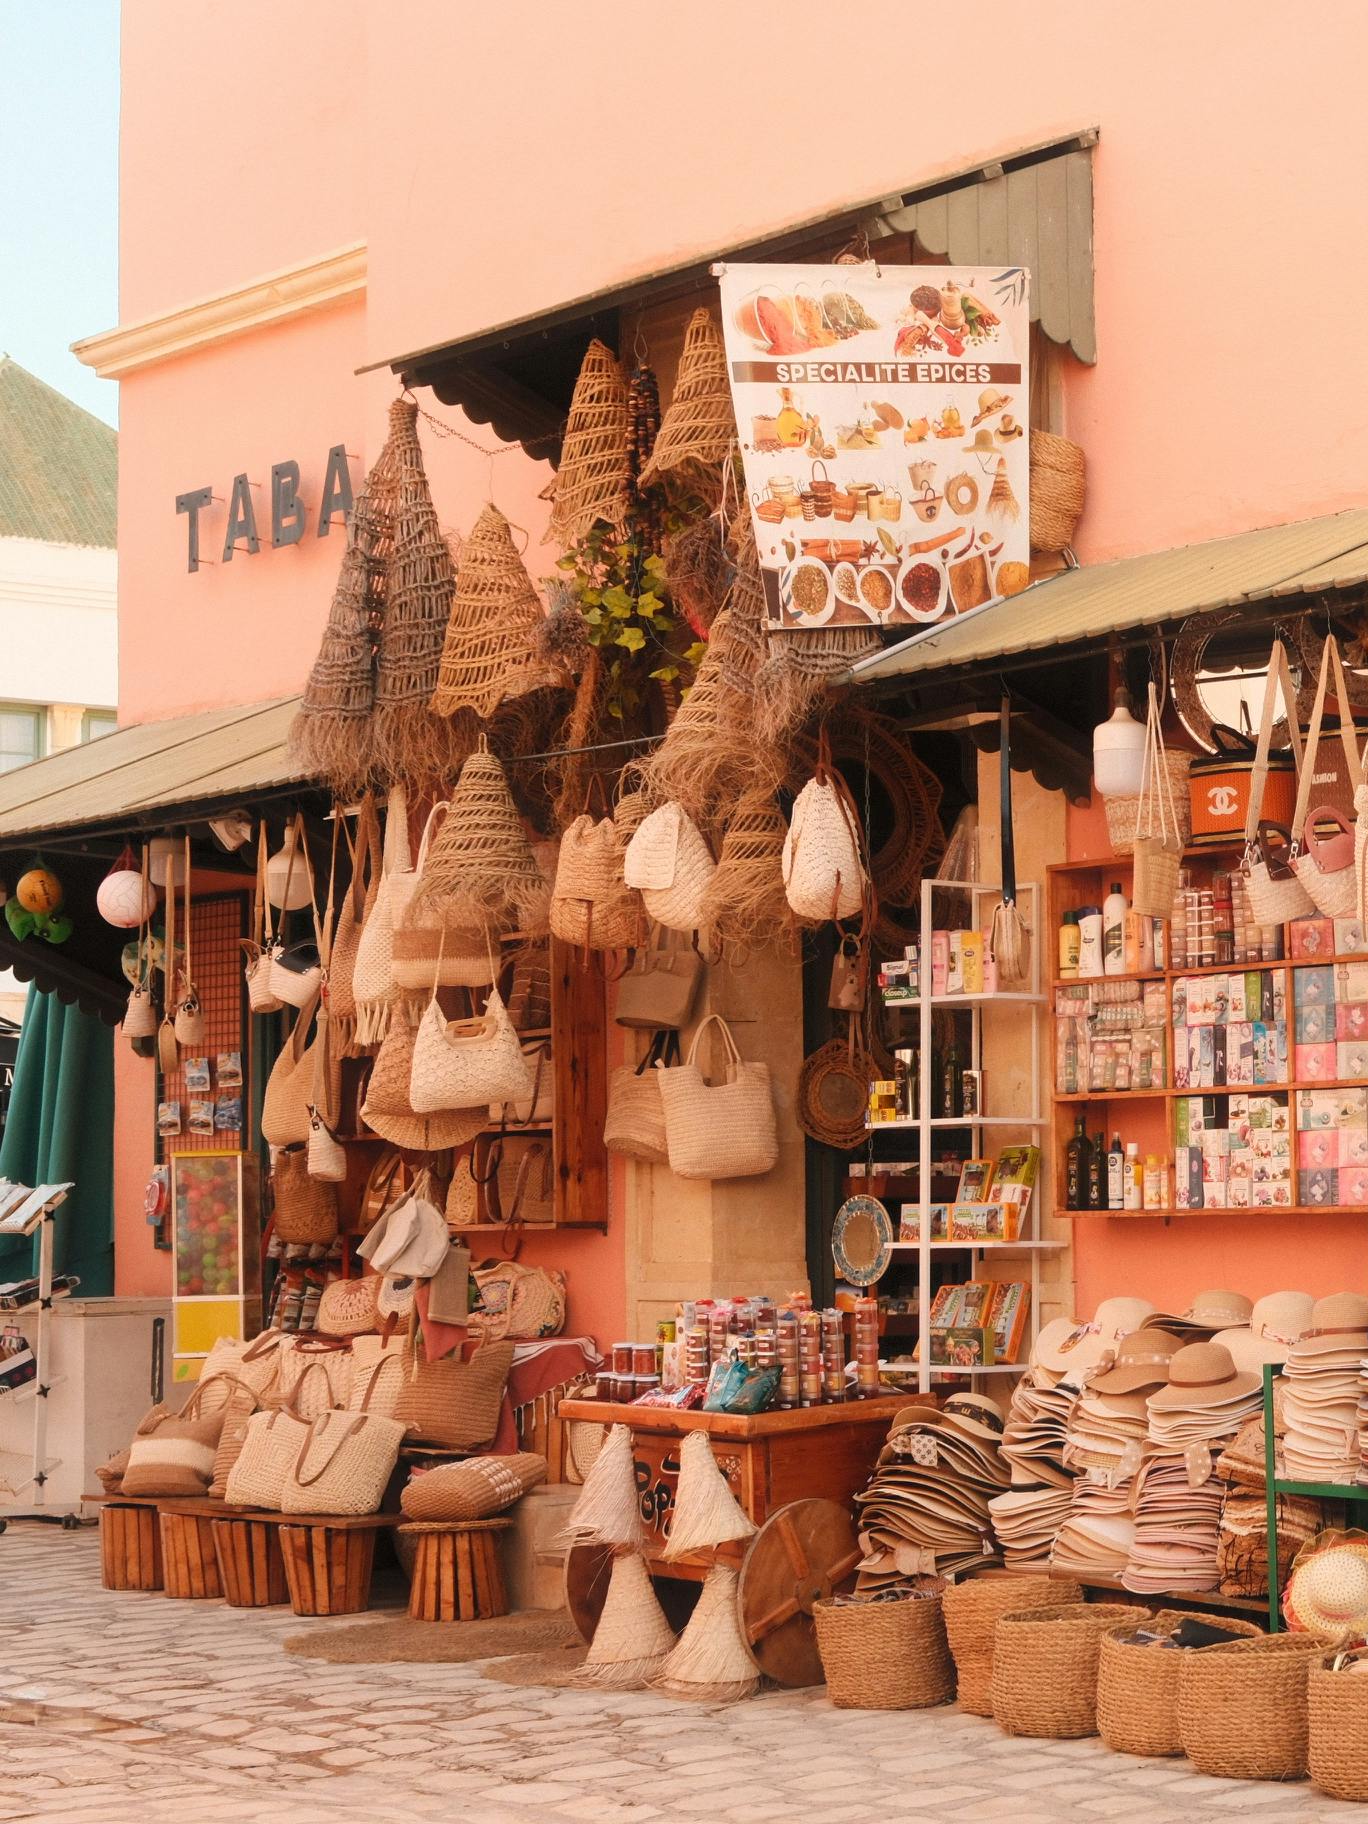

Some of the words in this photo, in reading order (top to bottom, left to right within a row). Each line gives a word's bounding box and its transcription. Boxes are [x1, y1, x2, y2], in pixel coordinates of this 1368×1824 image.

[776, 363, 911, 383] SPECIALITE
[916, 364, 992, 383] EPICES
[175, 444, 355, 574] TABA
[1311, 771, 1338, 785] ASHION
